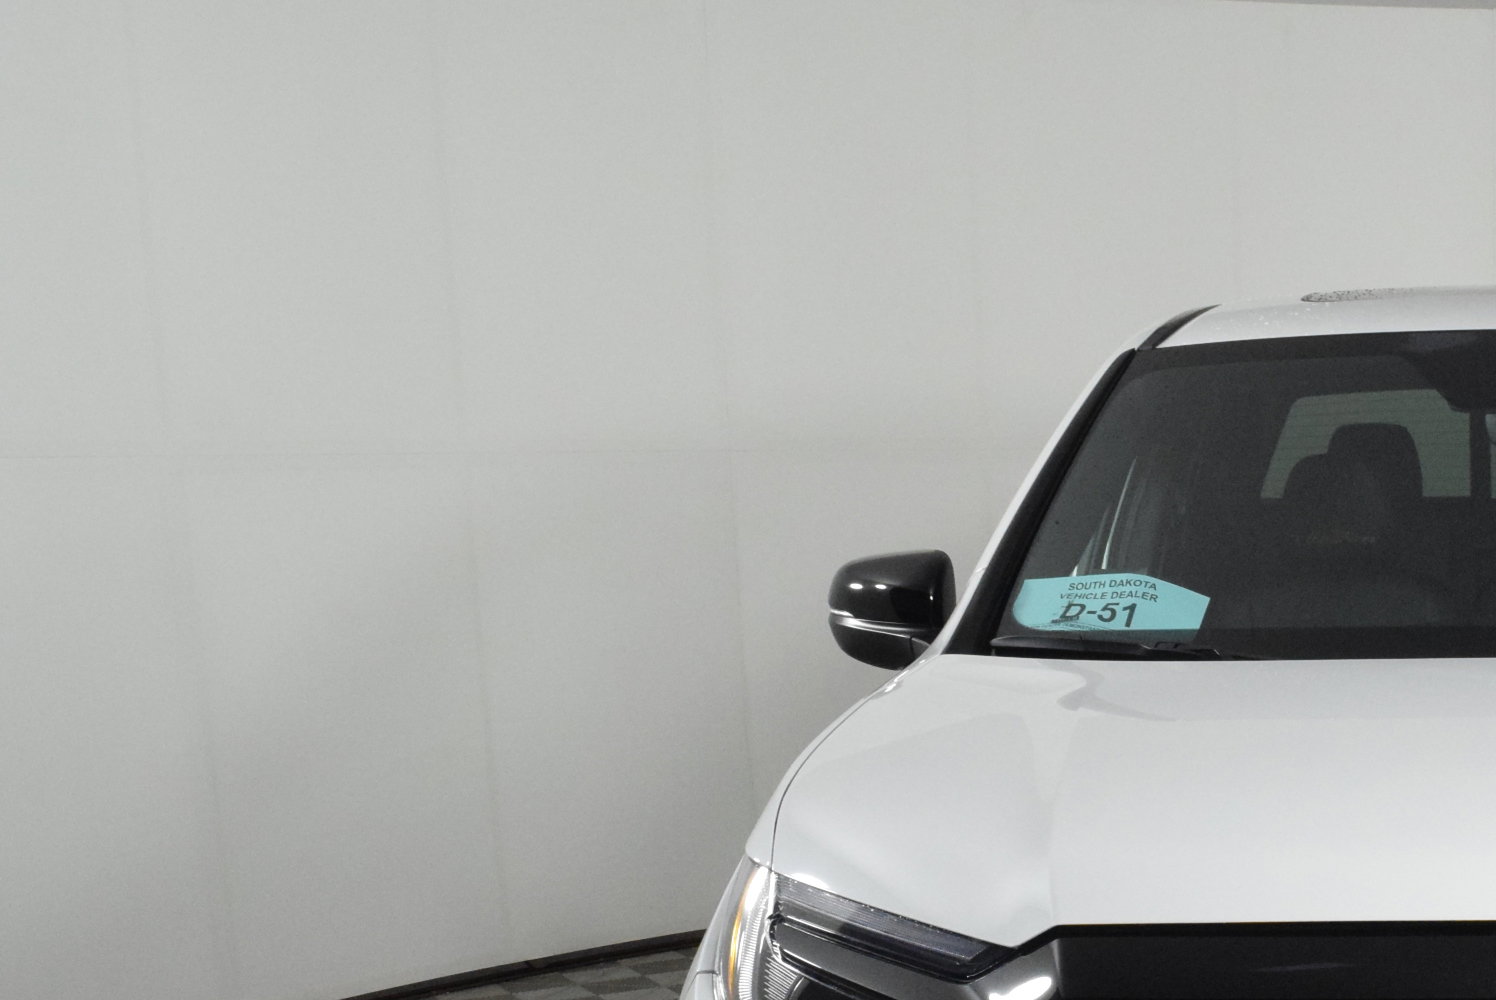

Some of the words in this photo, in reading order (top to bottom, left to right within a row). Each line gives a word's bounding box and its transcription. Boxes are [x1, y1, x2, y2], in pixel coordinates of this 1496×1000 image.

[1068, 580, 1106, 591] SOUTH
[1109, 579, 1157, 591] DAKOTA
[1060, 592, 1108, 600] VEHICLE
[1110, 591, 1159, 603] DEALER
[1060, 602, 1138, 628] D-51
